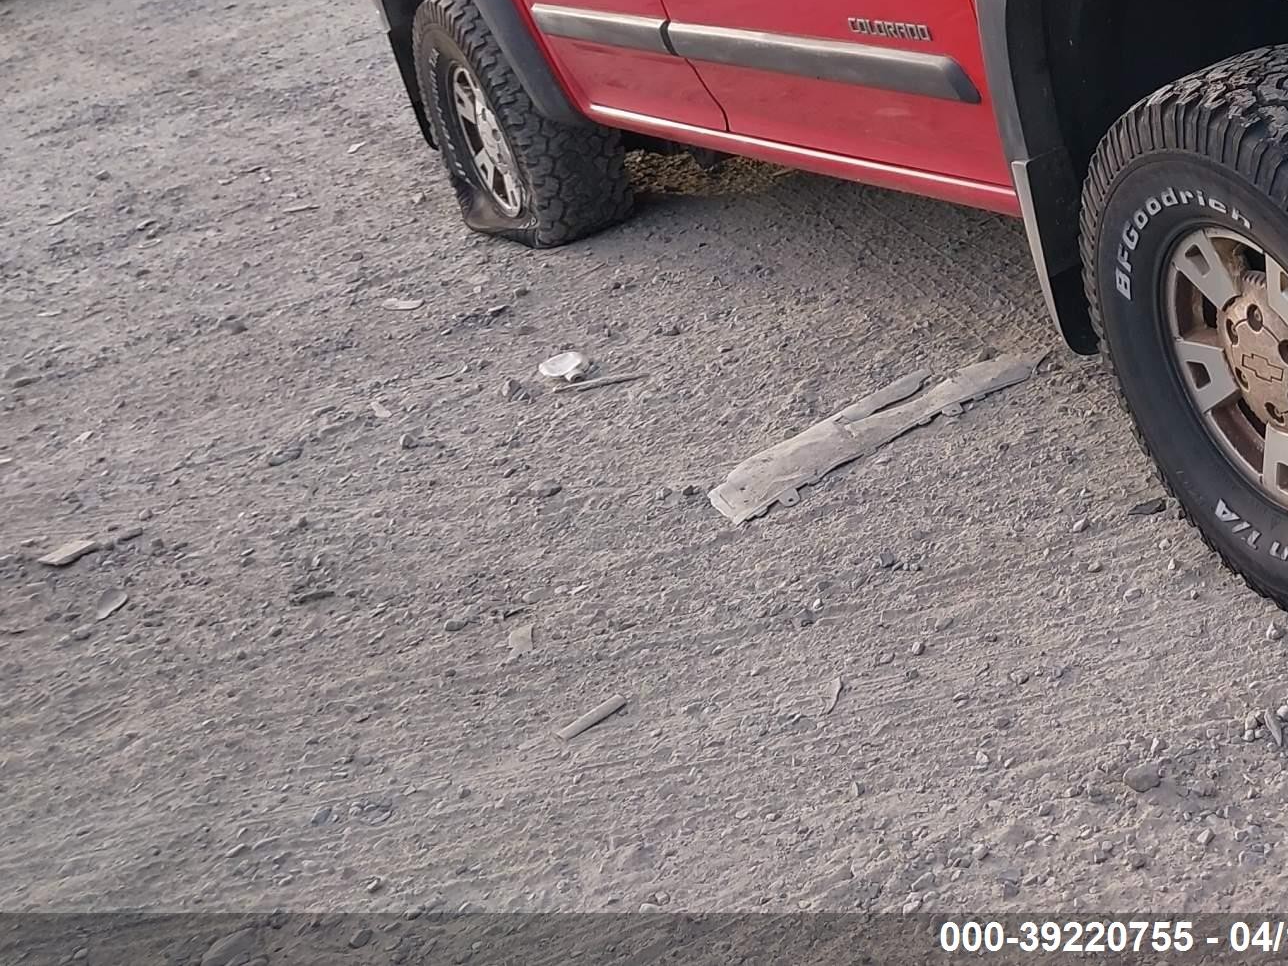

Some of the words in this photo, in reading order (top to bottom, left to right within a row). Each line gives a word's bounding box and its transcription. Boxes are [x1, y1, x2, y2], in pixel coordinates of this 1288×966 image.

[847, 17, 933, 42] COLORADO
[1115, 187, 1252, 300] BFGoodrich
[1214, 498, 1262, 550] T/A
